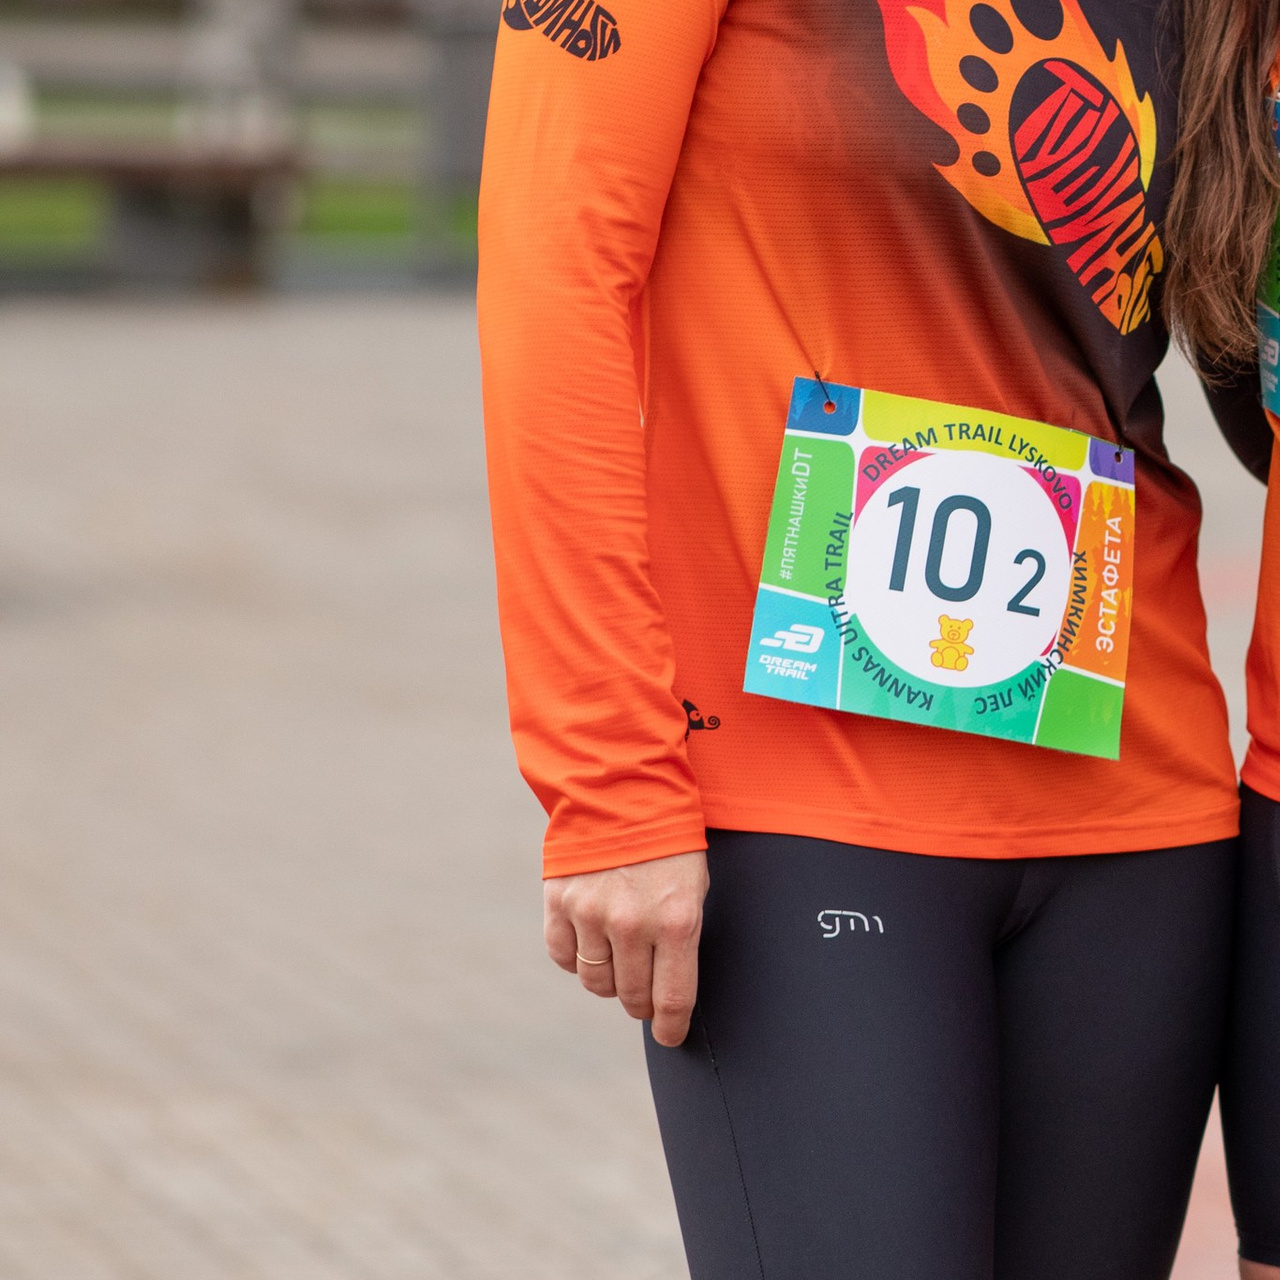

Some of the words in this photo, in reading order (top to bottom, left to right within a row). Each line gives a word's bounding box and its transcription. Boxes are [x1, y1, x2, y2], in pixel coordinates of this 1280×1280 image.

[861, 426, 940, 484] DREAM
[944, 422, 1004, 447] TRAIL
[1008, 433, 1073, 512] LYSKOVO
[824, 511, 854, 570] TRAIL
[886, 485, 992, 602] 10
[1006, 548, 1047, 617] 2
[1095, 516, 1122, 653] ЭСТАФЕТА
[1017, 550, 1088, 702] ХИМКИНСКИЙ
[758, 653, 818, 673] DREAM
[765, 663, 810, 681] TRAIL
[852, 646, 934, 711] KANNAS
[974, 687, 1013, 716] ЛЕС
